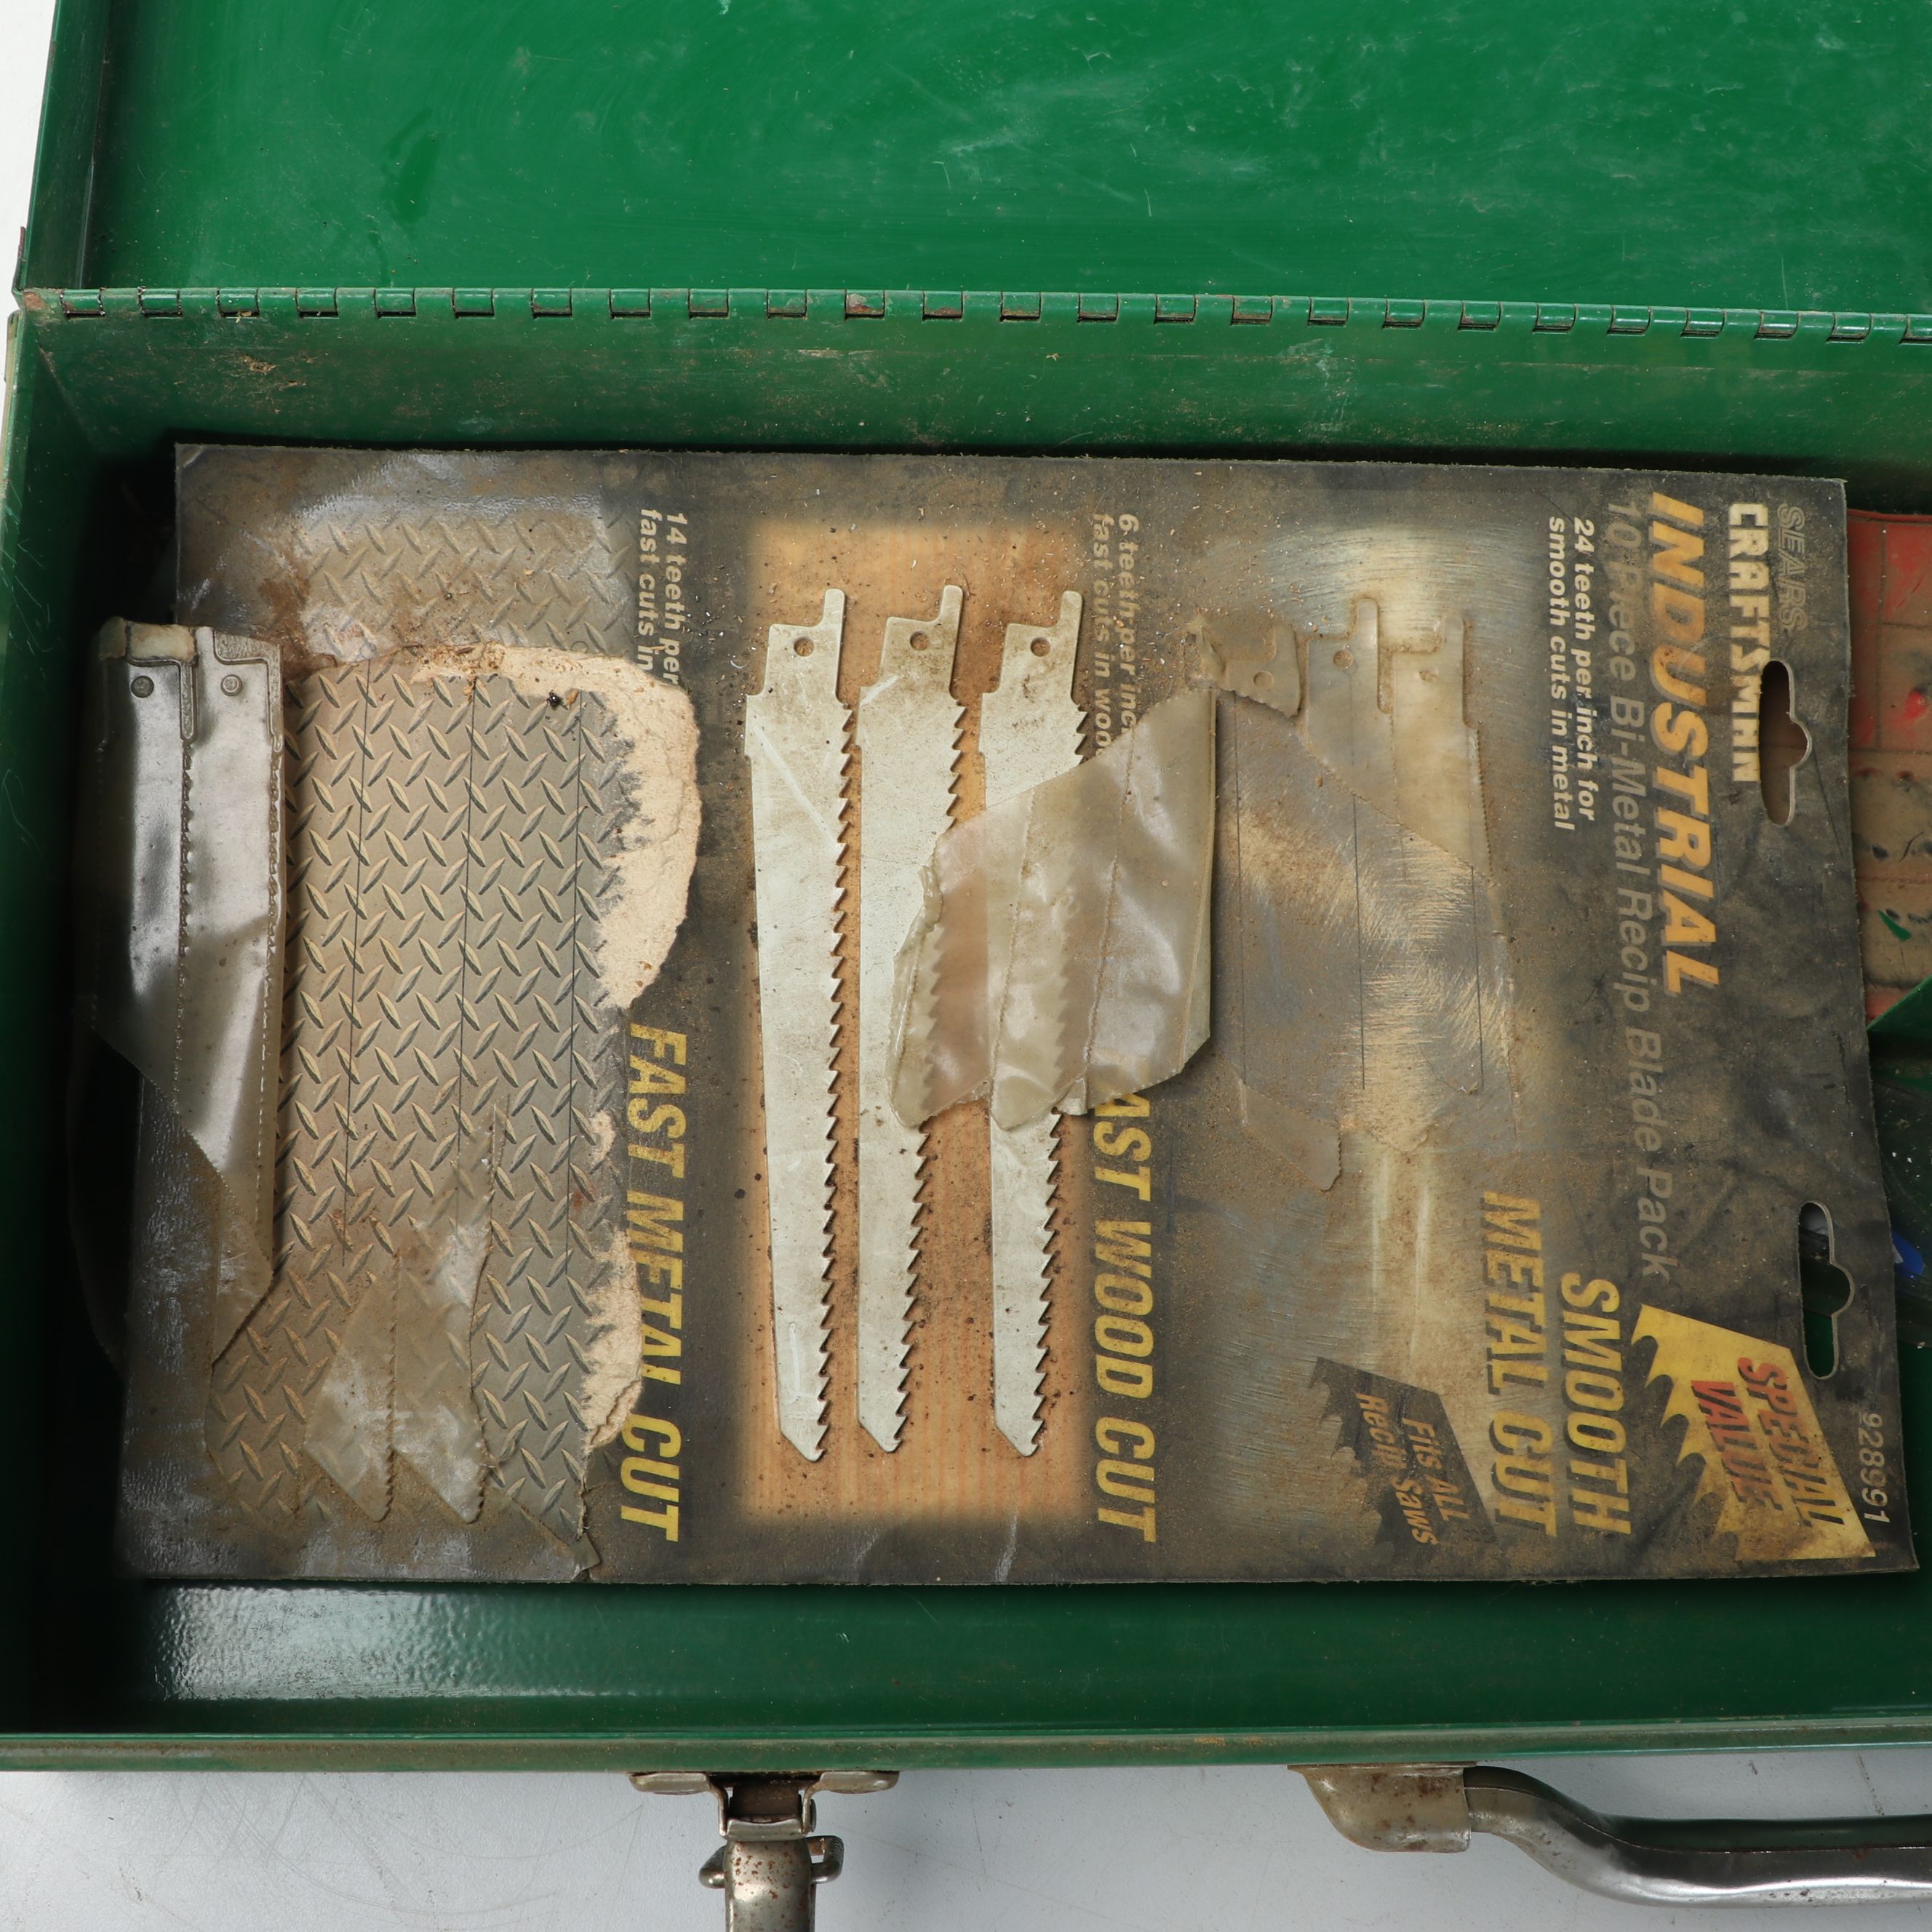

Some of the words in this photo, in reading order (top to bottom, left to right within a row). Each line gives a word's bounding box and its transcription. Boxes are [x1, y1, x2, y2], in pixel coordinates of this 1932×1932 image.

[639, 508, 663, 565] fast
[666, 512, 688, 545] 14
[1092, 513, 1117, 571] fast
[1118, 513, 1141, 533] 6
[1573, 517, 1595, 554] 24
[1776, 503, 1808, 631] SEARS
[636, 573, 659, 637] cuts
[663, 554, 687, 631] teeth
[1093, 578, 1115, 644] cuts
[1117, 540, 1141, 618] teeth
[1548, 516, 1570, 626] smooth
[1573, 562, 1597, 640] teeth
[636, 645, 659, 671] in
[658, 637, 681, 685] per
[1093, 653, 1115, 679] in
[1114, 625, 1138, 676] per
[1549, 635, 1570, 700] cuts
[1570, 649, 1593, 698] per
[1728, 502, 1771, 783] CRAFTSMAN
[1119, 683, 1142, 735] inc
[1551, 708, 1573, 736] in
[1576, 706, 1598, 770] inch
[1649, 491, 1720, 997] INDUSTRIAL
[1552, 745, 1576, 831] metal
[1578, 780, 1600, 821] for
[1608, 695, 1651, 875] Bi-Metal
[1613, 885, 1656, 1013] Recip
[625, 1021, 687, 1178] FAST
[1624, 1027, 1668, 1154] Blade
[1092, 1093, 1152, 1202] AST
[1634, 1165, 1680, 1285] Pack
[1092, 1219, 1154, 1400] WOOD
[1481, 1190, 1549, 1395] METAL
[1558, 1272, 1632, 1537] SMOOTH
[1691, 1380, 1784, 1512] VALUE
[1738, 1357, 1845, 1528] SPECIAL
[620, 1413, 682, 1542] CUT
[1094, 1416, 1157, 1544] CUT
[1354, 1392, 1410, 1469] Recip
[1389, 1474, 1440, 1546] Saws
[1401, 1418, 1445, 1469] Fits
[1426, 1474, 1471, 1523] ALL
[1489, 1410, 1558, 1538] CUT
[1859, 1412, 1891, 1523] 928991
